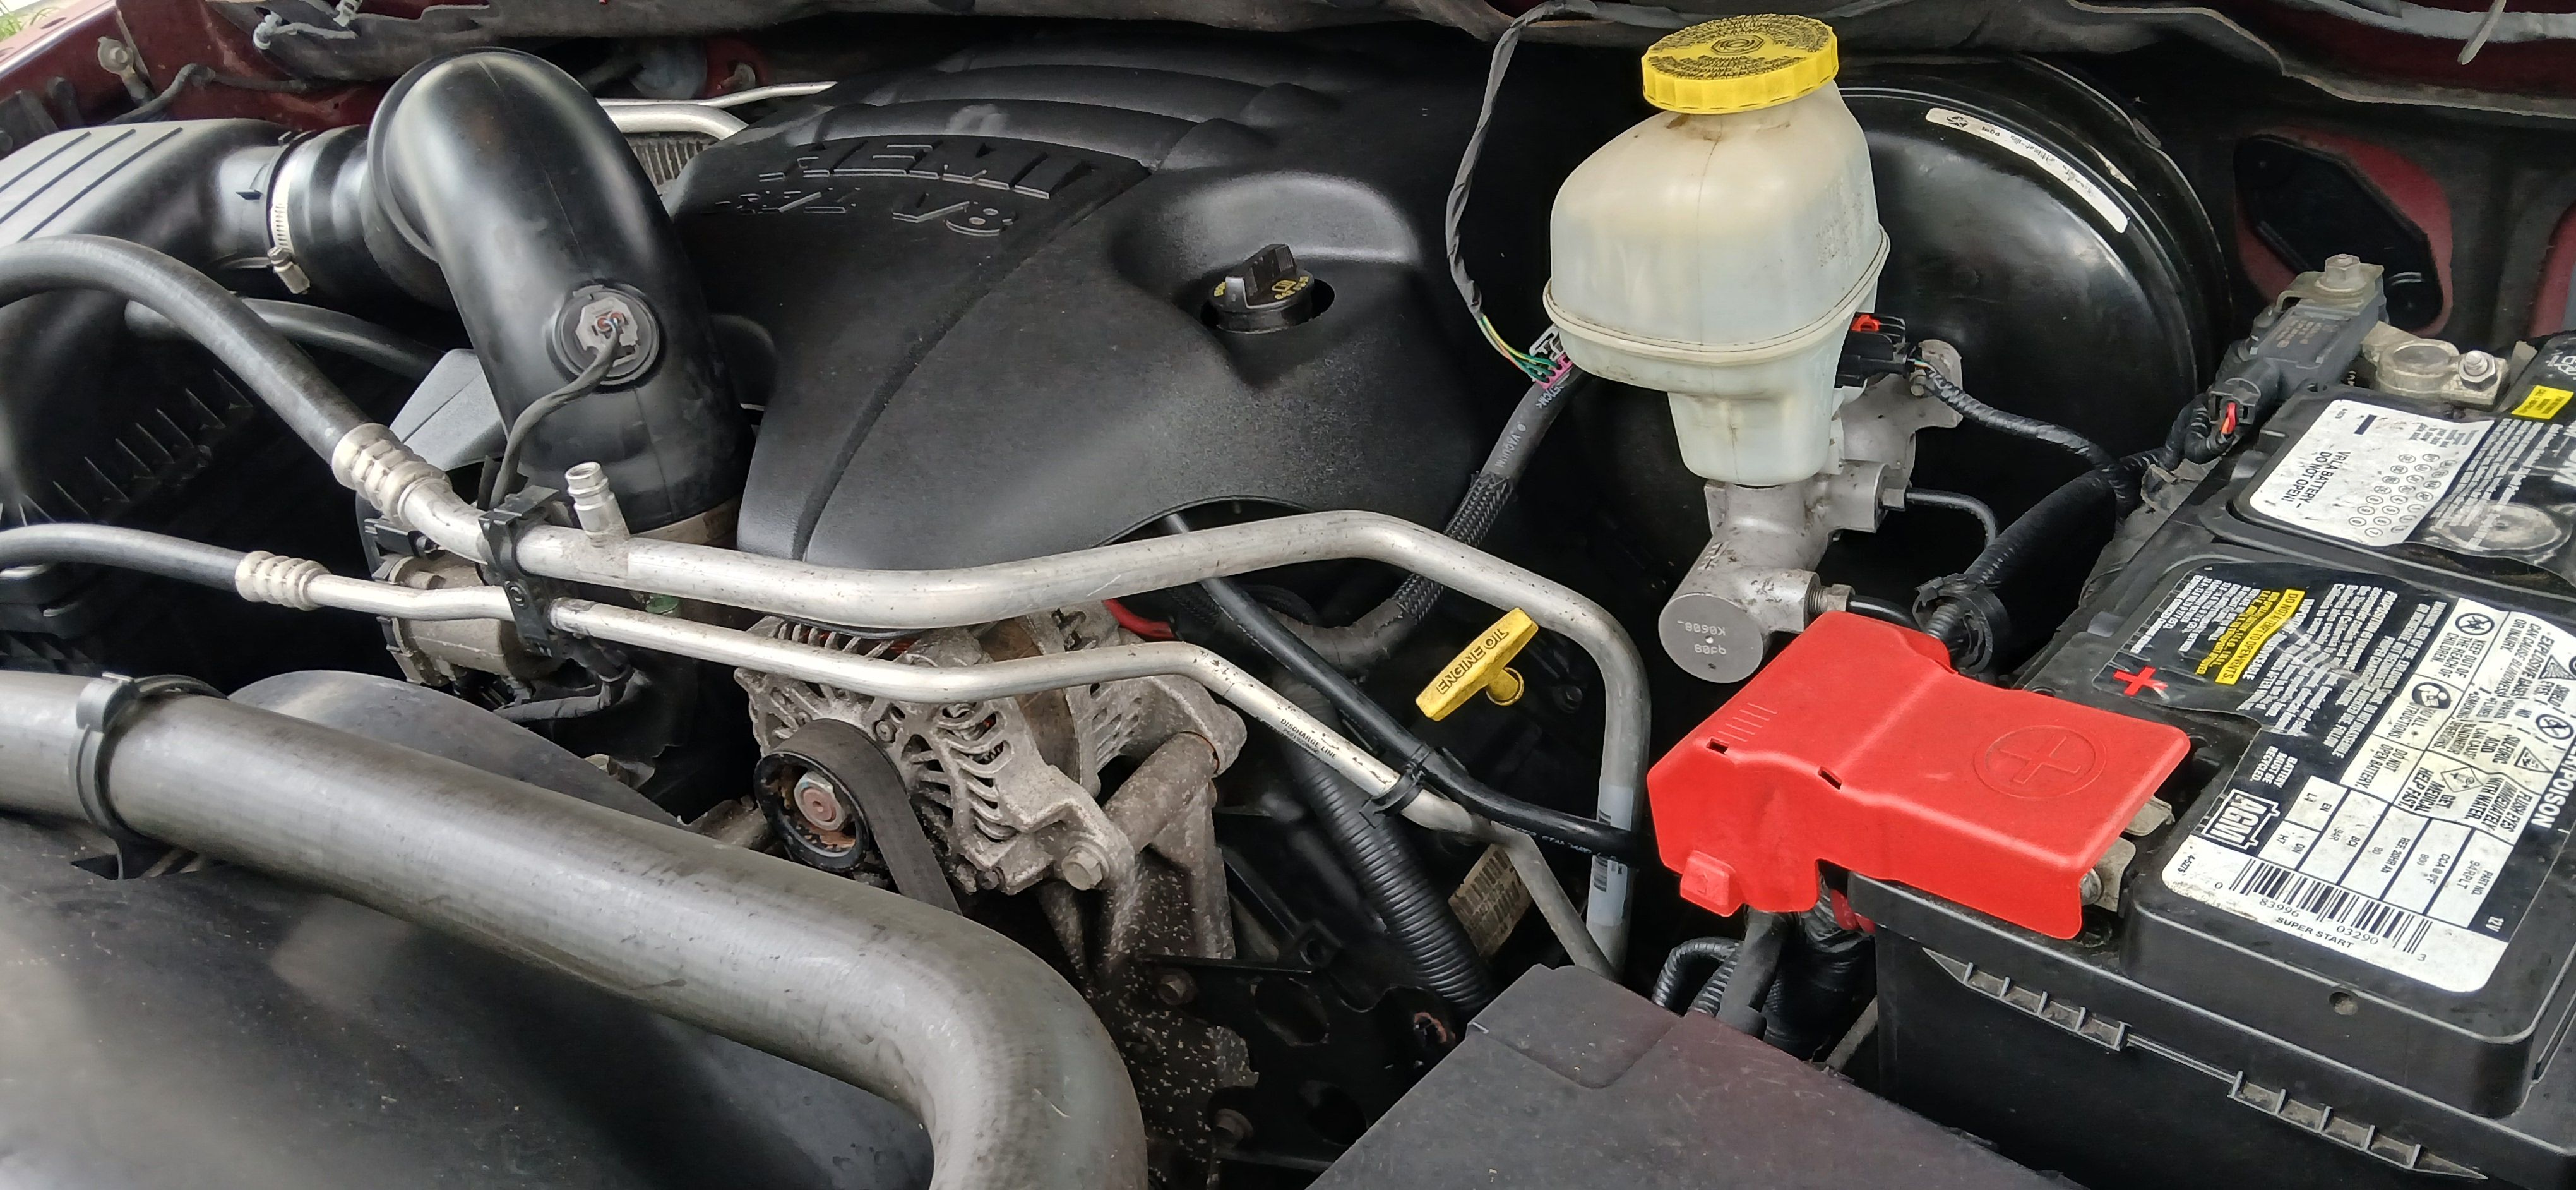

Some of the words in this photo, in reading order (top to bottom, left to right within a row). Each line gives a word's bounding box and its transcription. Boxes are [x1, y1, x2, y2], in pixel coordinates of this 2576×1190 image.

[1494, 434, 1522, 469] VACUUM
[2313, 450, 2332, 464] DO
[2325, 449, 2351, 471] VRLA
[2301, 462, 2322, 479] NOT
[2281, 478, 2310, 503] OPEN!
[2298, 469, 2334, 503] BATTERY
[2282, 592, 2299, 604] DO
[2275, 603, 2292, 616] NOT
[2280, 596, 2318, 634] IMPORTANT
[2359, 590, 2402, 633] PROPOSITION
[2257, 614, 2282, 635] ATTEMPT
[2512, 618, 2527, 630] OR
[2524, 623, 2543, 639] CAN
[2248, 631, 2263, 642] TO
[2455, 634, 2472, 649] THE
[2466, 637, 2486, 656] KEEP
[2498, 627, 2524, 653] INJURY.
[2430, 631, 2459, 665] CHILDREN.
[2443, 647, 2465, 669] REACH
[2512, 636, 2536, 661] CAUSE
[2519, 635, 2557, 679] EXPLOSIVE
[1436, 647, 1486, 694] ENGINE
[1484, 628, 1510, 652] OIL
[2459, 654, 2477, 669] OUT
[2257, 670, 2281, 690] AFTER
[2437, 667, 2453, 678] OF
[2454, 666, 2469, 678] OF
[2491, 658, 2525, 697] BLINDNESS
[2508, 676, 2533, 699] GASES
[2532, 678, 2555, 699] EYES.
[2545, 683, 2570, 707] SHIELD
[2411, 716, 2428, 729] ALL
[2513, 707, 2532, 719] NO
[1280, 718, 1320, 748] DISCHARGE
[1320, 745, 1337, 759] LINE
[2322, 723, 2347, 748] FOLLOW
[2471, 726, 2488, 741] CAN
[2372, 742, 2394, 761] OPEN
[2391, 748, 2407, 760] DO
[2478, 735, 2501, 755] ACID
[2490, 733, 2522, 767] SULFURIC
[2248, 745, 2279, 784] RECYCLED.
[2267, 751, 2287, 774] MUST
[2271, 755, 2299, 788] BATTERY
[2383, 757, 2401, 772] NOT
[2261, 772, 2275, 784] BE
[2354, 759, 2383, 790] BATTERY.
[2409, 767, 2434, 790] HELP
[2480, 774, 2504, 796] WITH
[2303, 792, 2317, 803] L4
[2318, 802, 2332, 812] EN
[2397, 787, 2422, 810] FAST.
[2413, 780, 2446, 815] MEDICAL
[2436, 792, 2456, 809] GET
[2479, 781, 2521, 831] IMMEDIATELY
[2507, 790, 2534, 815] FLUSH
[2464, 793, 2493, 823] WATER.
[2211, 795, 2262, 844] AGM
[2498, 812, 2522, 832] EYES
[2274, 833, 2287, 844] H7
[2328, 827, 2344, 842] 94R
[2346, 834, 2361, 848] BCI
[2394, 836, 2411, 851] REF.
[2291, 842, 2305, 854] DIN
[2385, 849, 2402, 866] 20HR
[2380, 864, 2393, 874] Ah
[2415, 853, 2430, 866] 800
[2434, 852, 2451, 869] CCA
[2455, 859, 2481, 889] 94RPLT
[2476, 869, 2493, 886] PART
[2470, 884, 2484, 897] NO.
[2214, 882, 2223, 890] 0
[2259, 898, 2299, 918] 83996
[2337, 925, 2379, 946] 03290
[2486, 915, 2505, 932] 12V
[2276, 917, 2313, 938] SUPER
[2315, 929, 2354, 949] START
